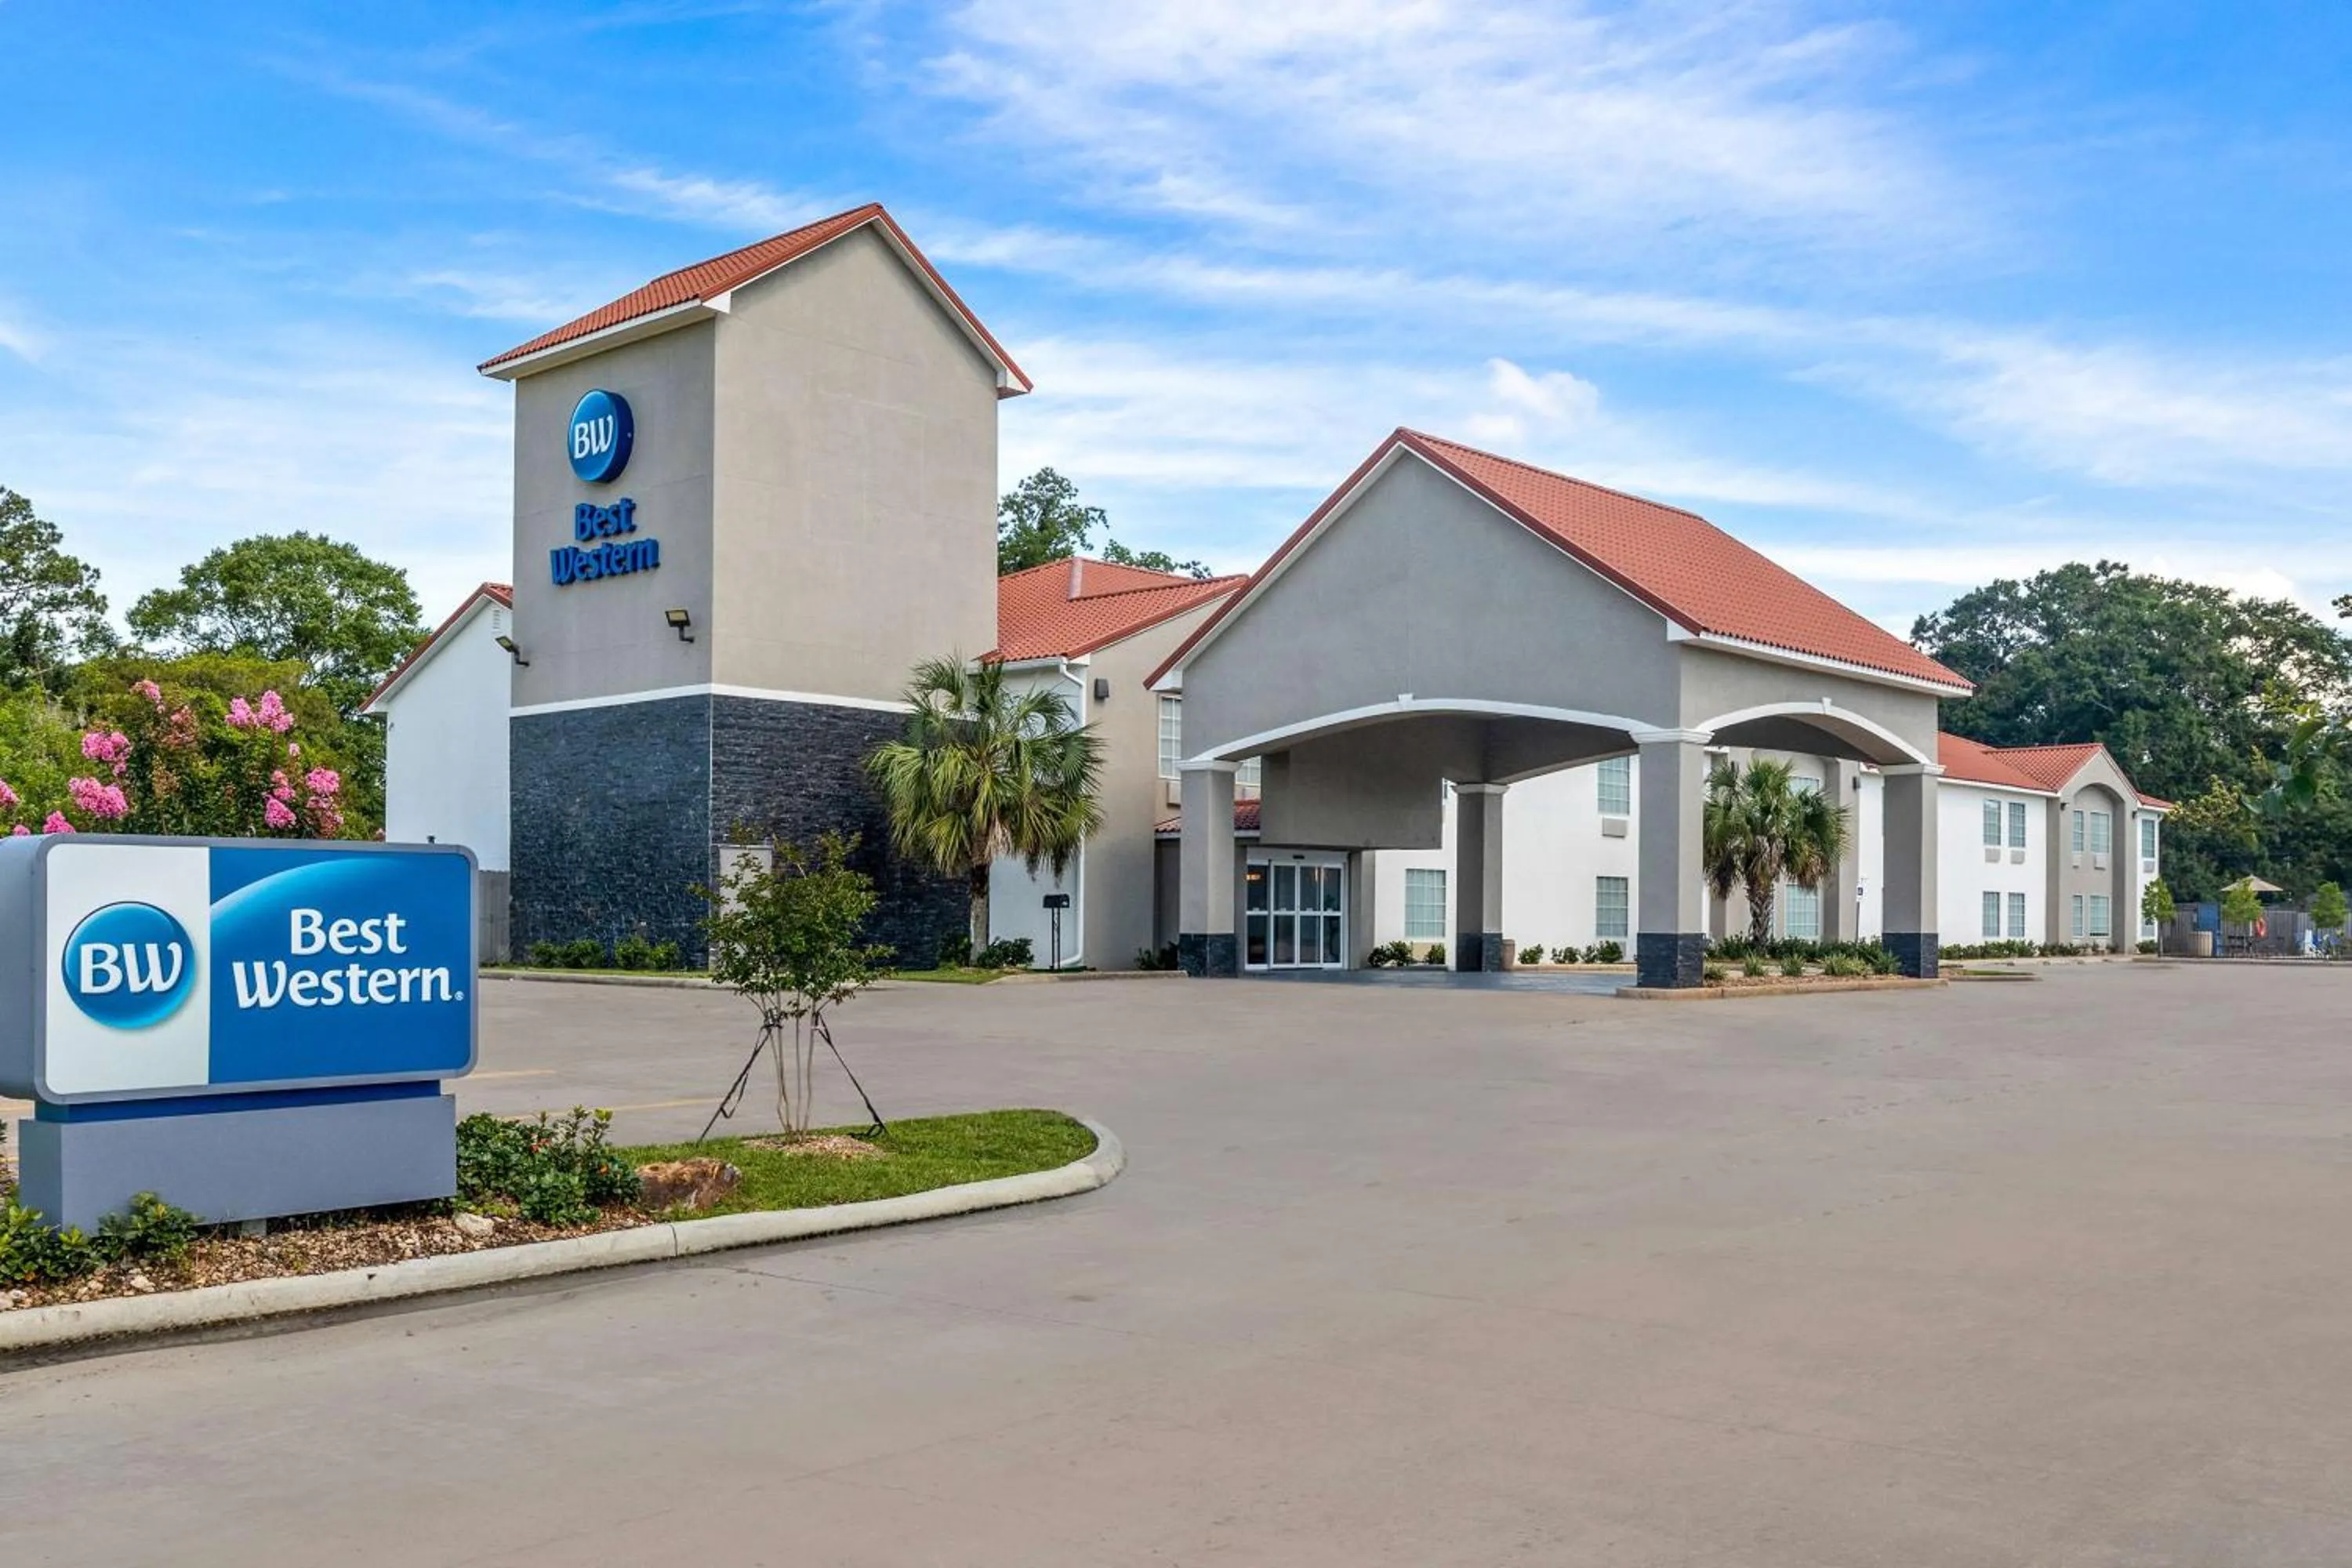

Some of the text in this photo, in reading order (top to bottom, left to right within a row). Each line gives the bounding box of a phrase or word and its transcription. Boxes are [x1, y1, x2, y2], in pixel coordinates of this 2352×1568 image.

[574, 415, 614, 459] BW
[575, 498, 637, 542] Best
[550, 538, 660, 585] Western
[291, 909, 407, 955] Best
[80, 942, 183, 994] BW
